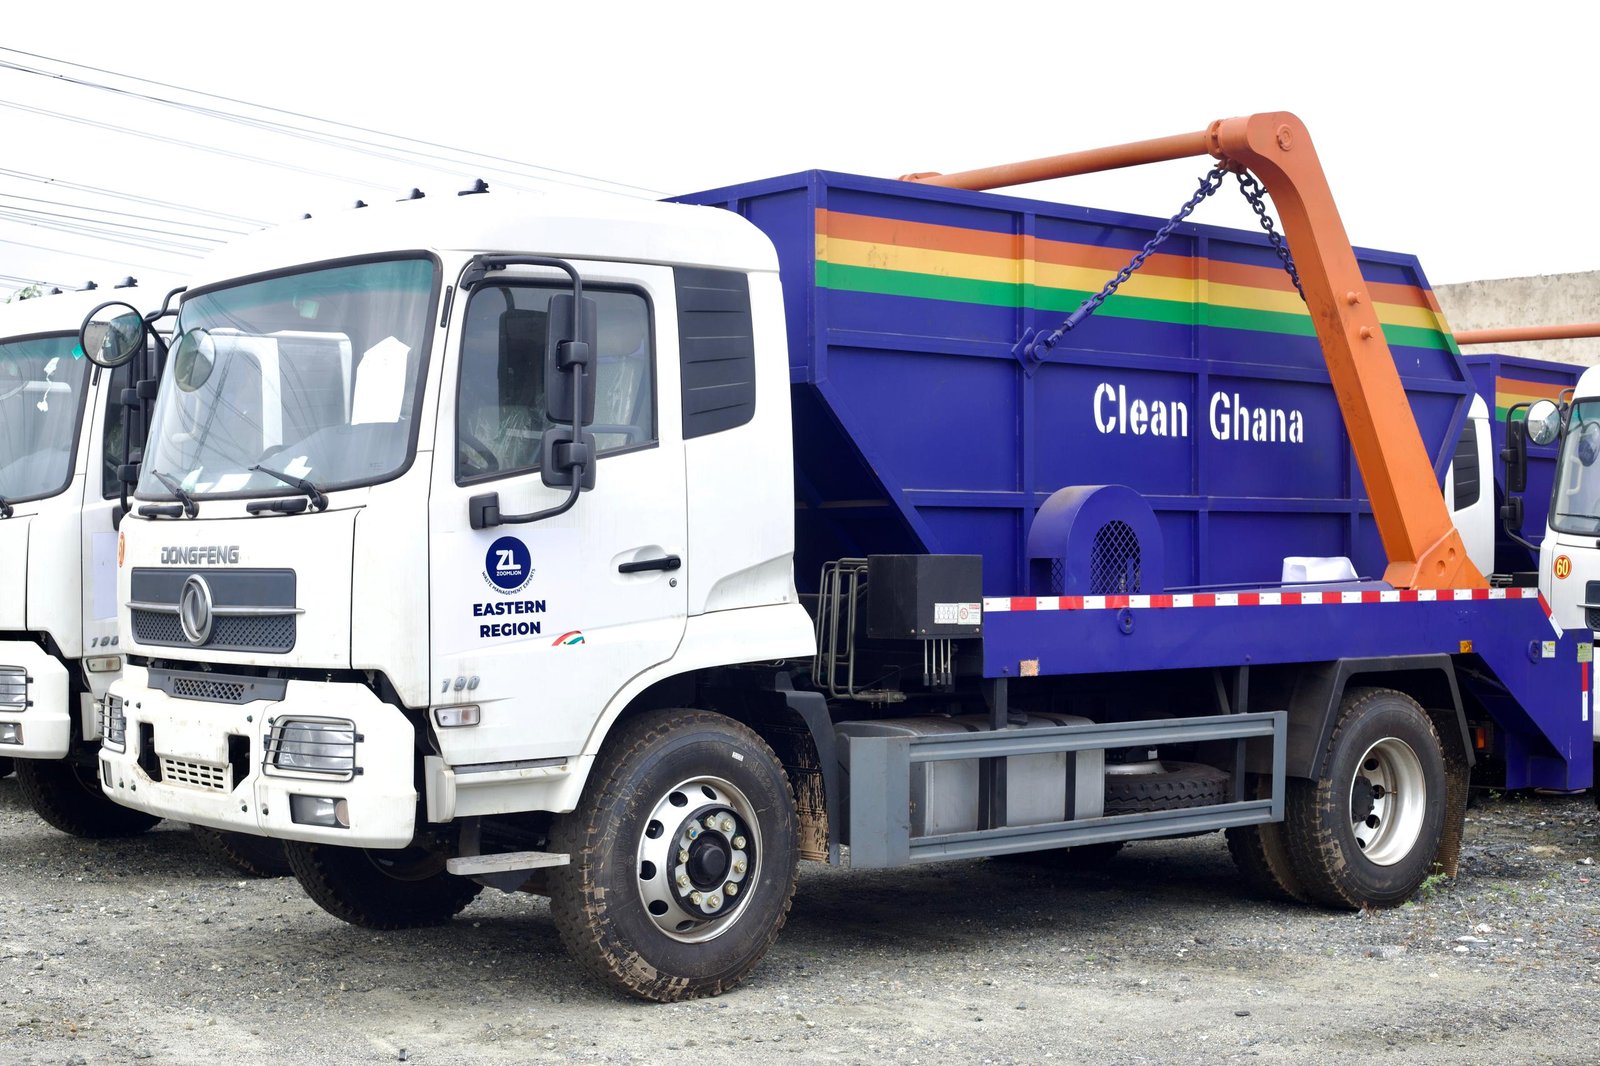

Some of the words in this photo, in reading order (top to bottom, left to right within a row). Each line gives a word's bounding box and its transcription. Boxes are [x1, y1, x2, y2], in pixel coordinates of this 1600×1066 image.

[1093, 382, 1188, 437] Clean
[1209, 391, 1304, 443] Ghana
[161, 545, 240, 565] DONGFENG
[495, 549, 522, 571] ZL
[1556, 558, 1569, 576] 60
[481, 570, 493, 588] WASTE
[491, 585, 524, 596] MANAGEMENT
[522, 568, 537, 589] EXPERTS
[473, 599, 547, 617] EASTERN
[479, 621, 541, 638] REGION
